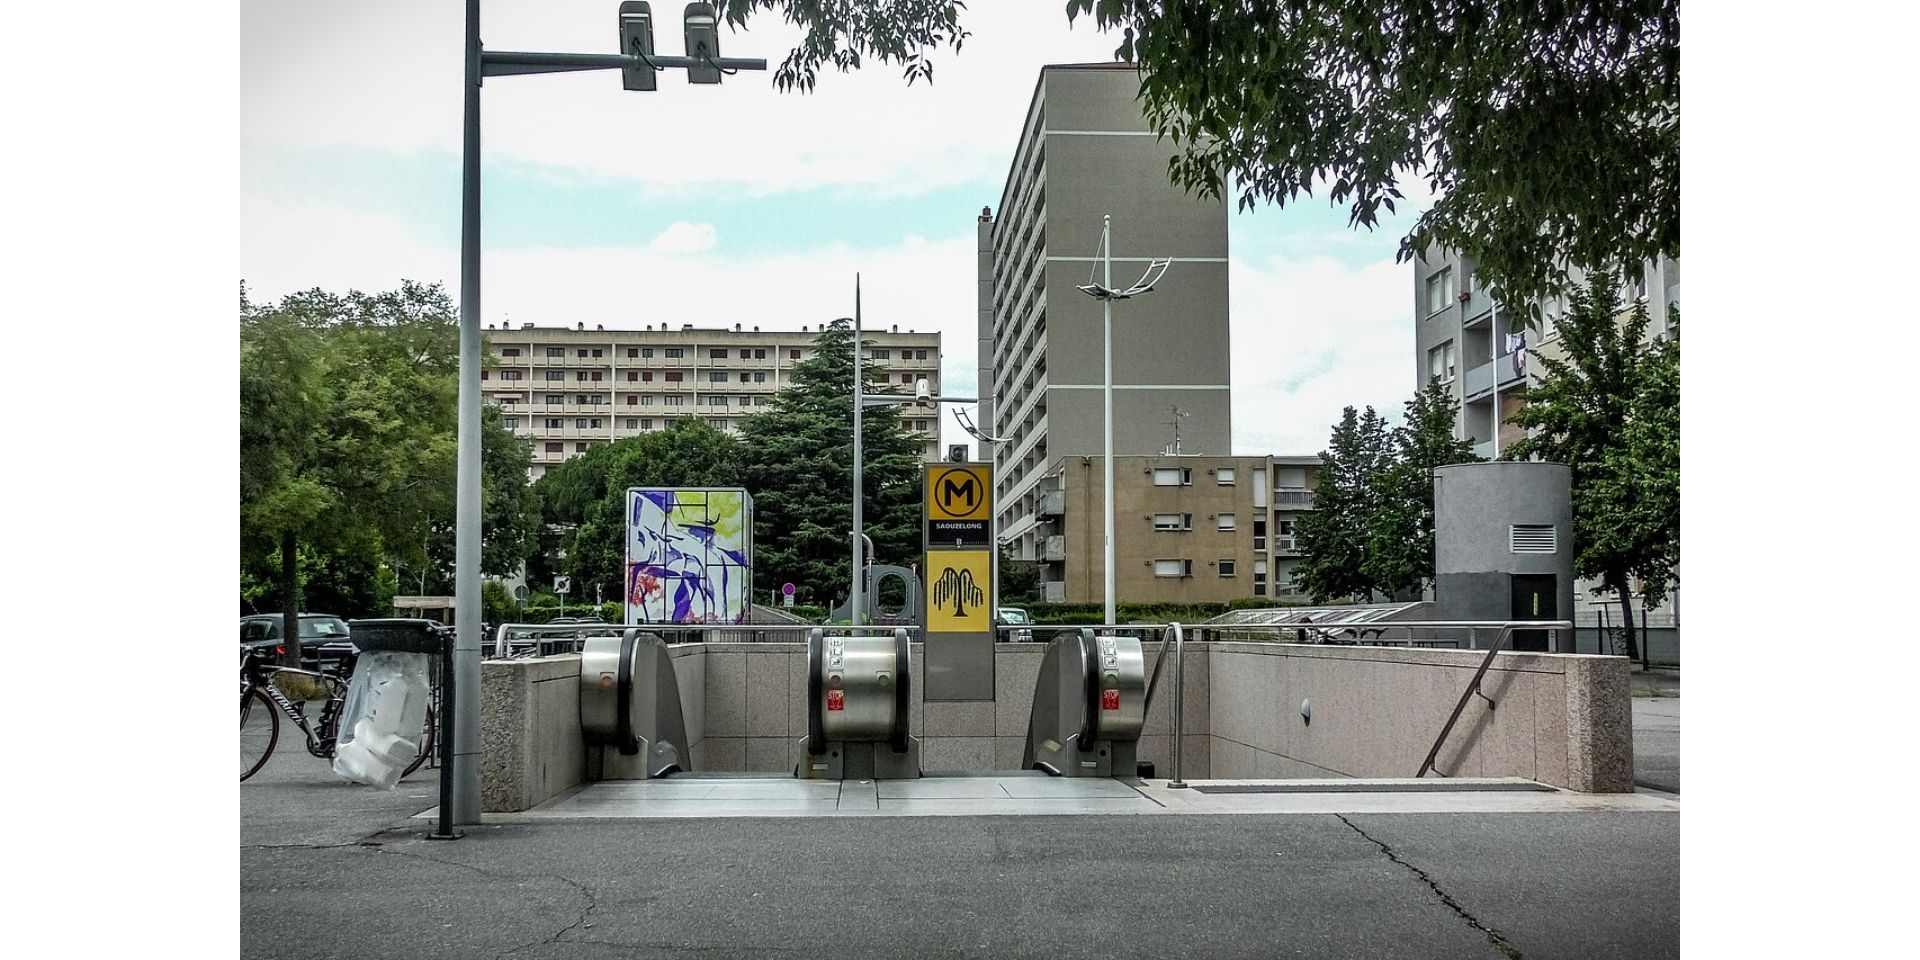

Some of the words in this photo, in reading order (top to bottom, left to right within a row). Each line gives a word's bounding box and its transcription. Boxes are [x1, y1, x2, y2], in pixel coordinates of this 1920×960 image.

[945, 479, 973, 506] M
[827, 690, 844, 700] STOP
[1103, 689, 1120, 699] STOP
